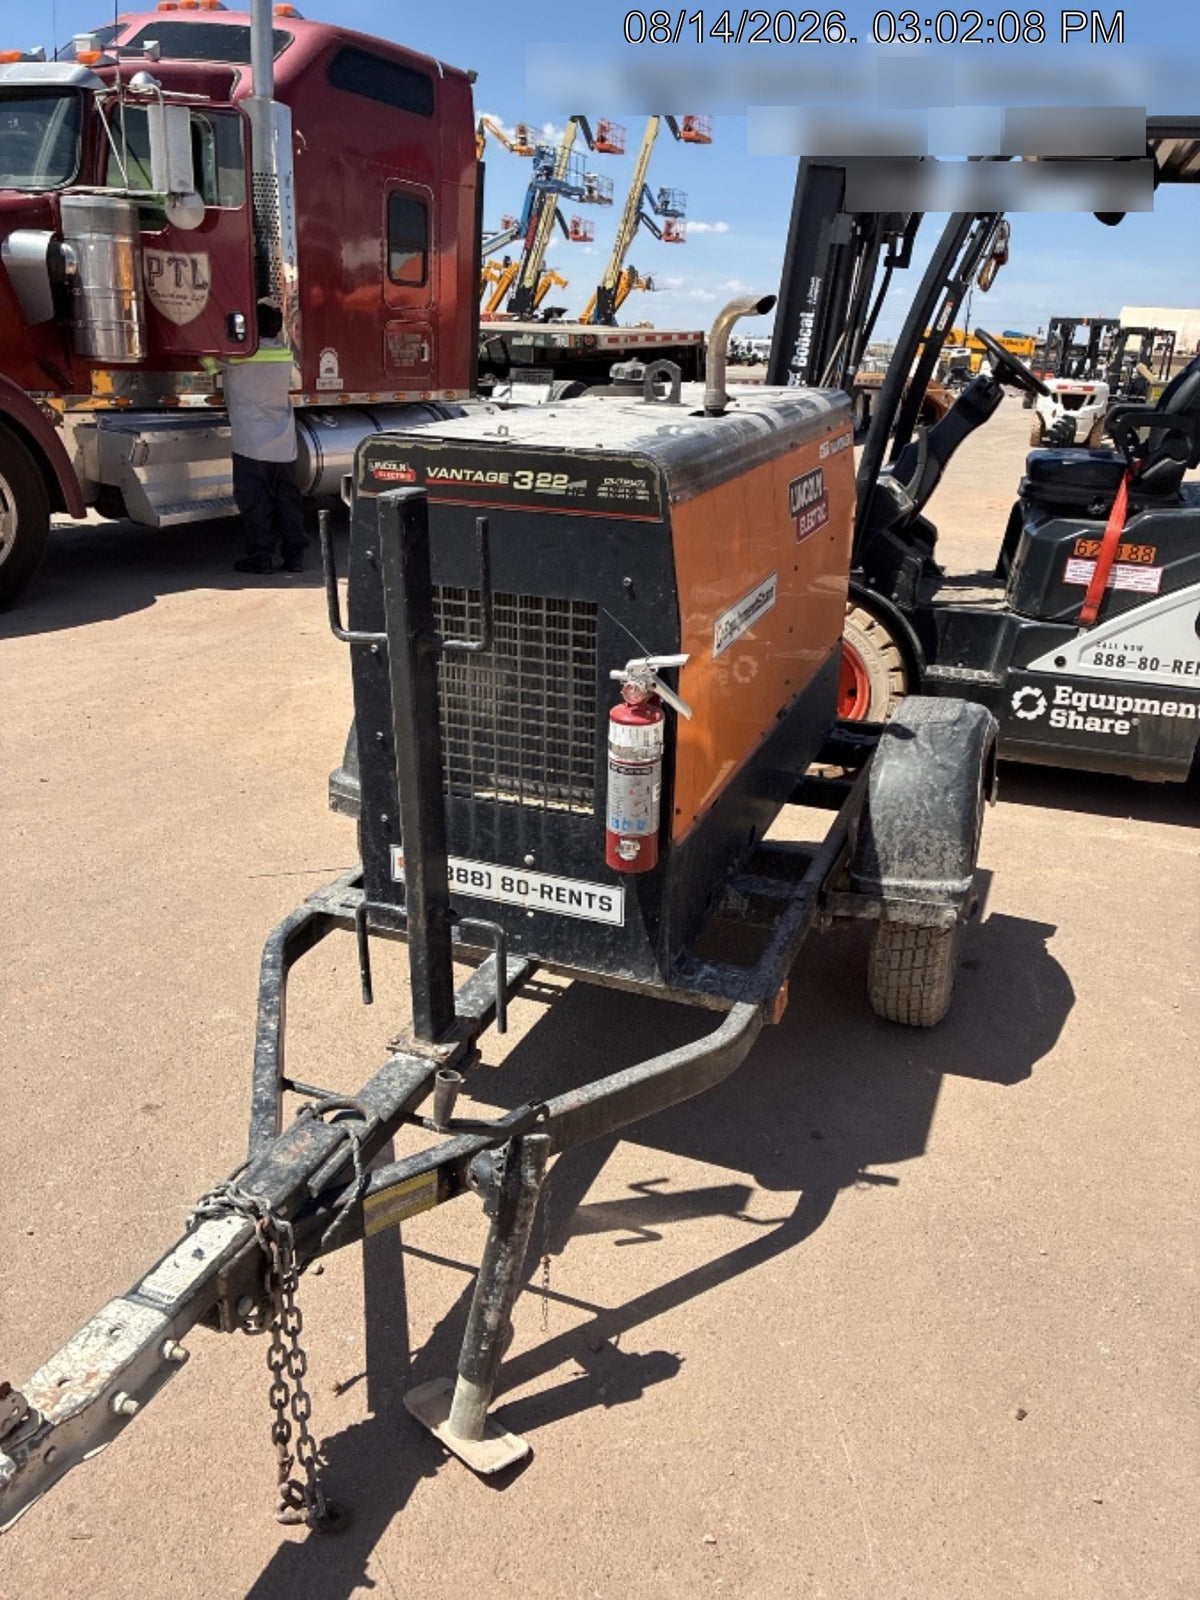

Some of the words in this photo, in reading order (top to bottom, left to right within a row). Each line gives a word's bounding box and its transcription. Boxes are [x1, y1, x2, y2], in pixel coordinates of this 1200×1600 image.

[147, 256, 208, 290] PTL
[791, 312, 815, 367] Bobcat
[426, 467, 511, 484] VANTAGE
[513, 470, 569, 490] 322
[791, 472, 822, 513] LINCOLN
[800, 502, 827, 536] ELECTRIC
[1076, 540, 1153, 562] 62188
[1123, 643, 1144, 652] NOW
[501, 875, 613, 912] 80-RENTS
